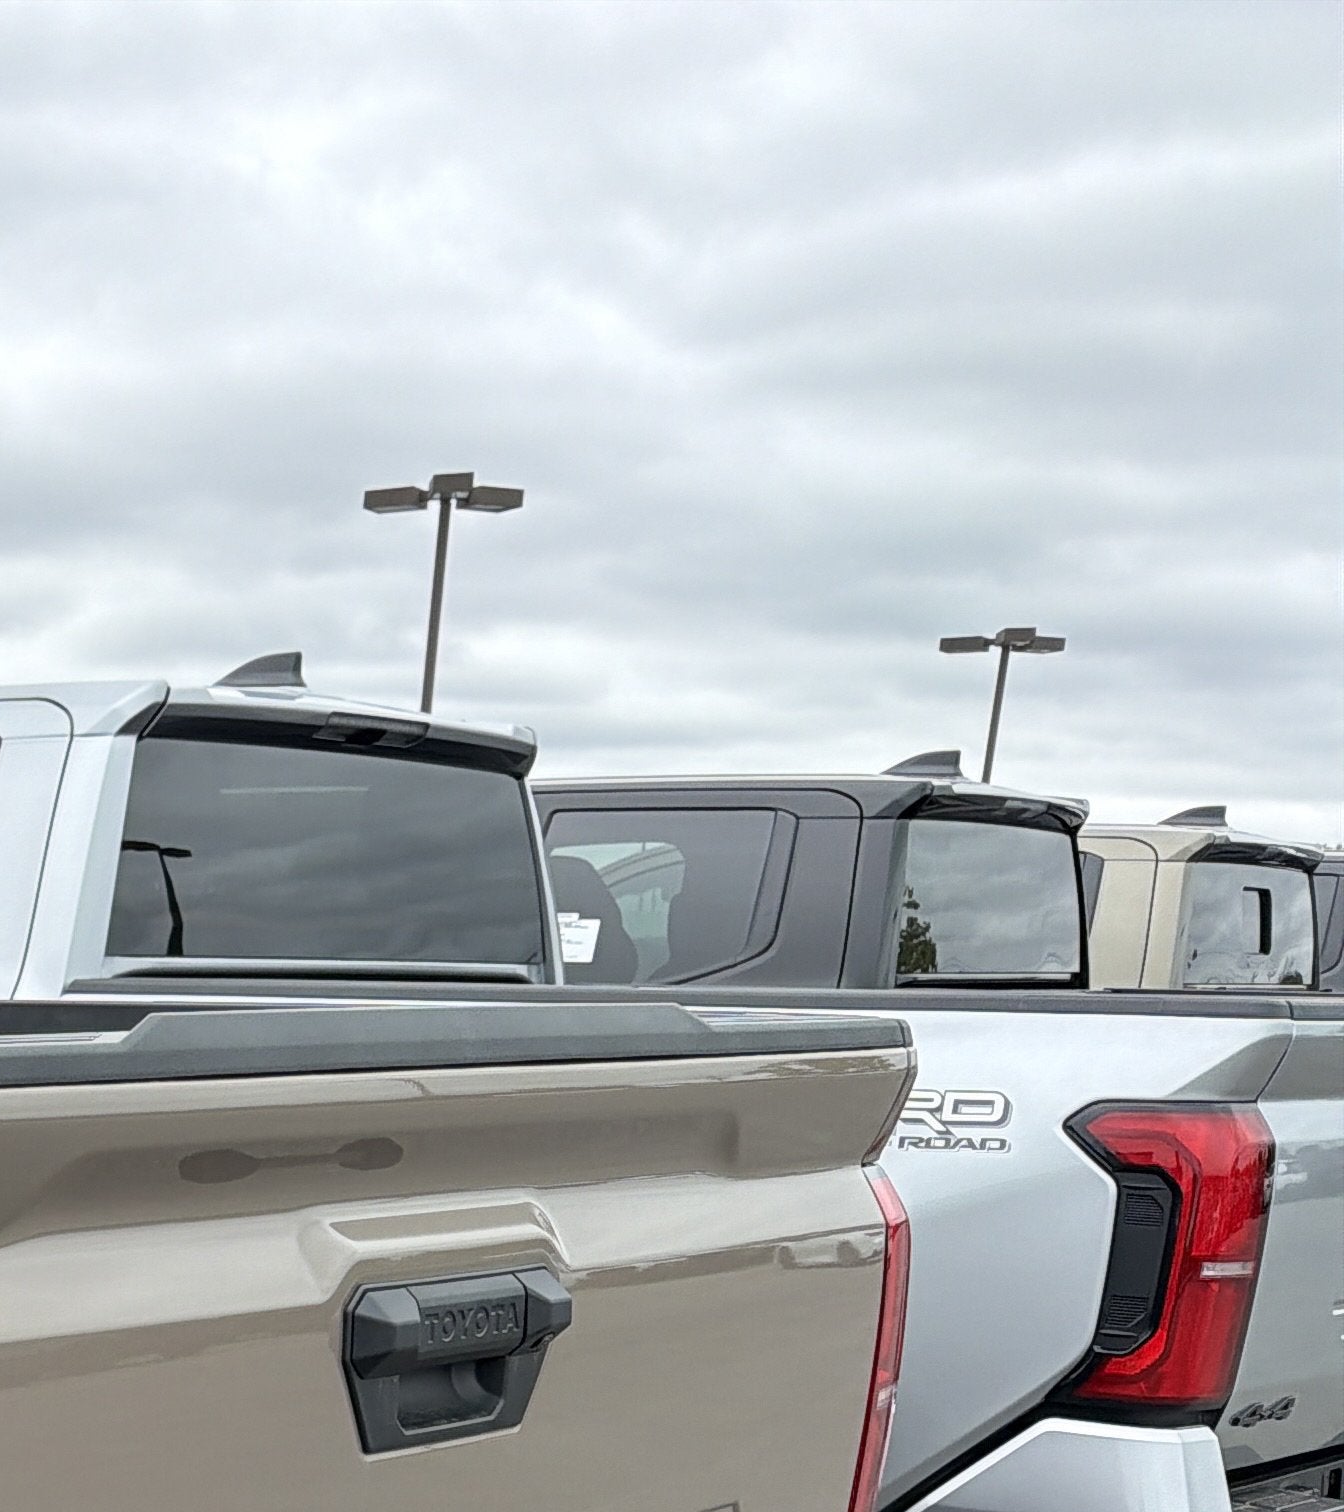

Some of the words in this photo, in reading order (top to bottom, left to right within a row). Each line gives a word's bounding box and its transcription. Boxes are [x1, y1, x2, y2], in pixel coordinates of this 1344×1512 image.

[899, 1089, 1013, 1138] RD
[898, 1135, 1011, 1153] ROAD
[424, 1302, 521, 1345] TOYOTA
